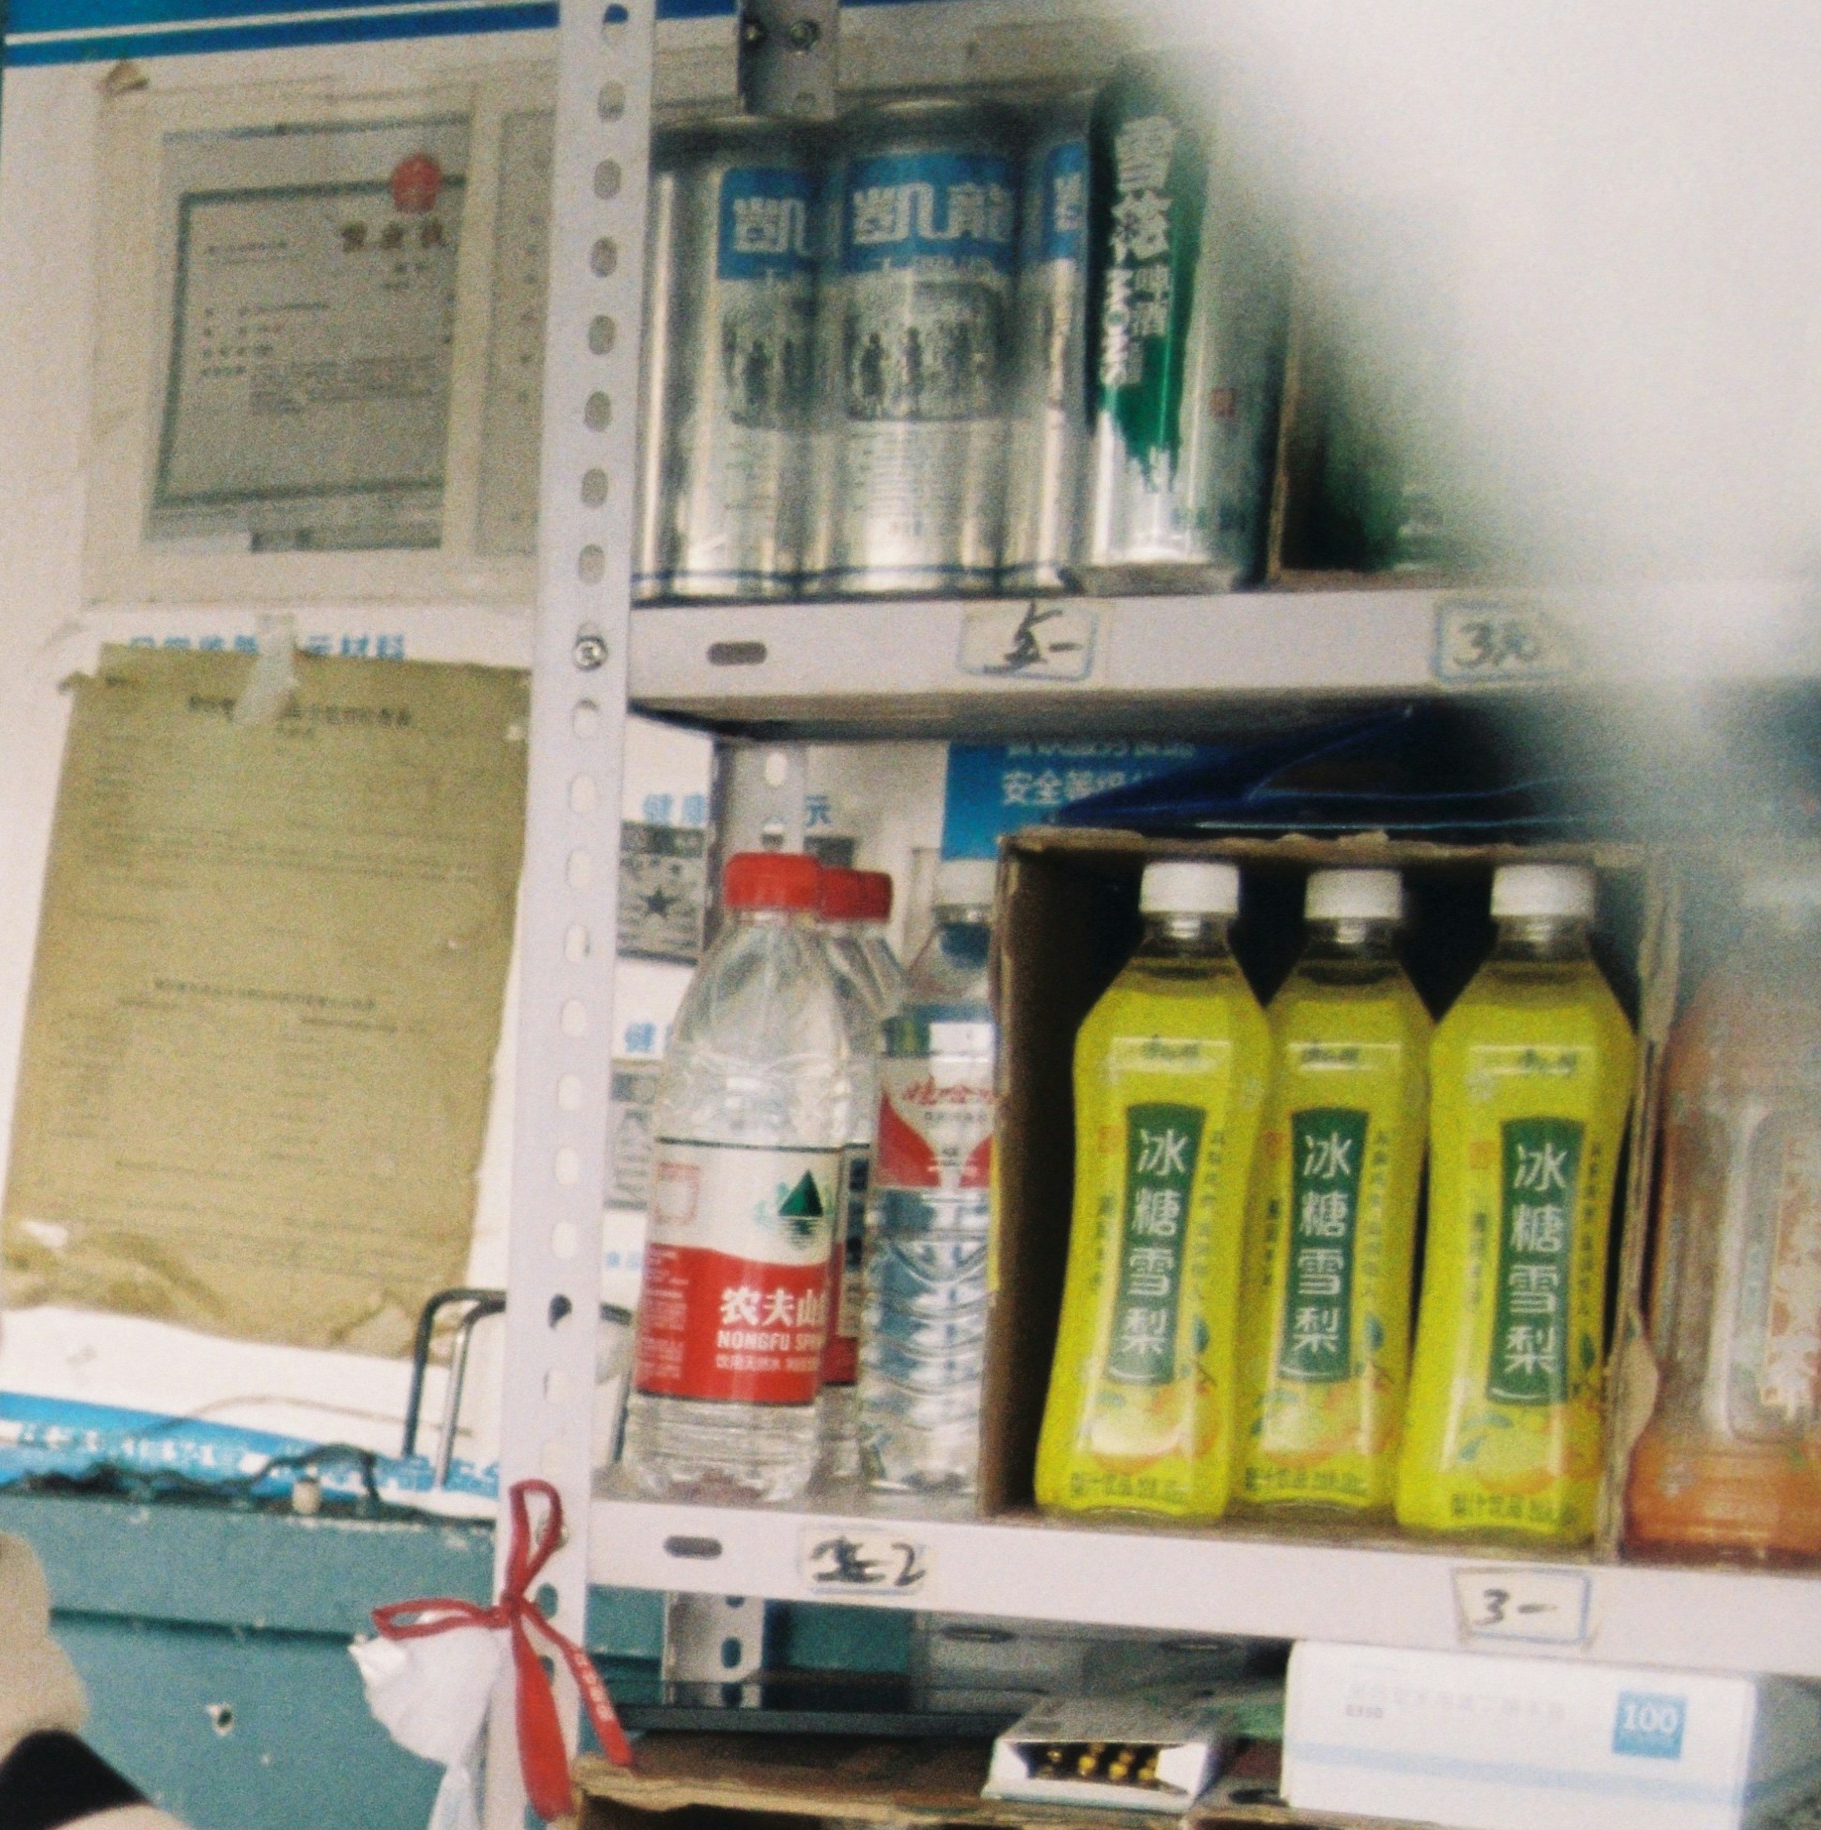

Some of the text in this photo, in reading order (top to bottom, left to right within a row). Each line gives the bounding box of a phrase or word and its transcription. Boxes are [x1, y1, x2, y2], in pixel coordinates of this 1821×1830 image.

[1121, 1129, 1189, 1356] 冰糖雪梨
[1293, 1132, 1353, 1355] 冰糖雪梨
[1504, 1142, 1567, 1376] 冰糖雪梨
[1622, 1703, 1679, 1735] 100
